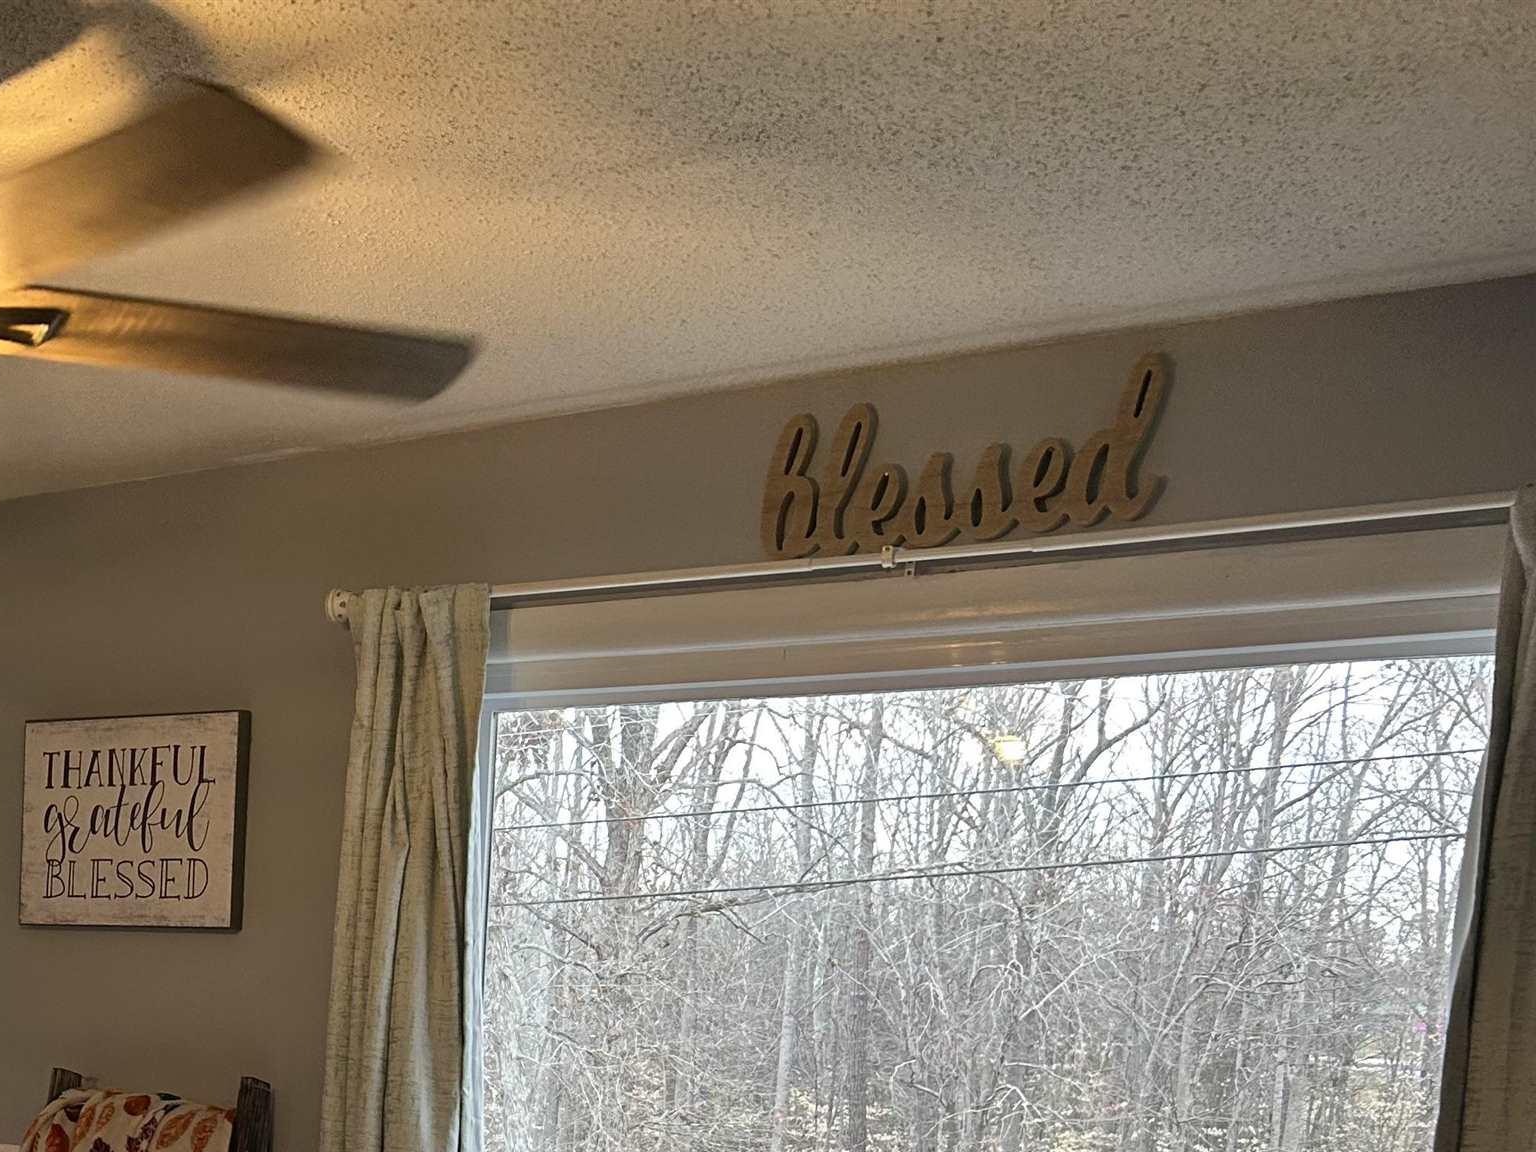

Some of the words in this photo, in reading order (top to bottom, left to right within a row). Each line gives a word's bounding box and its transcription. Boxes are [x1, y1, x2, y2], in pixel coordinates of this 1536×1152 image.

[43, 744, 215, 790] THANKFUL
[43, 780, 211, 867] grateful
[42, 858, 209, 901] BLESSED
